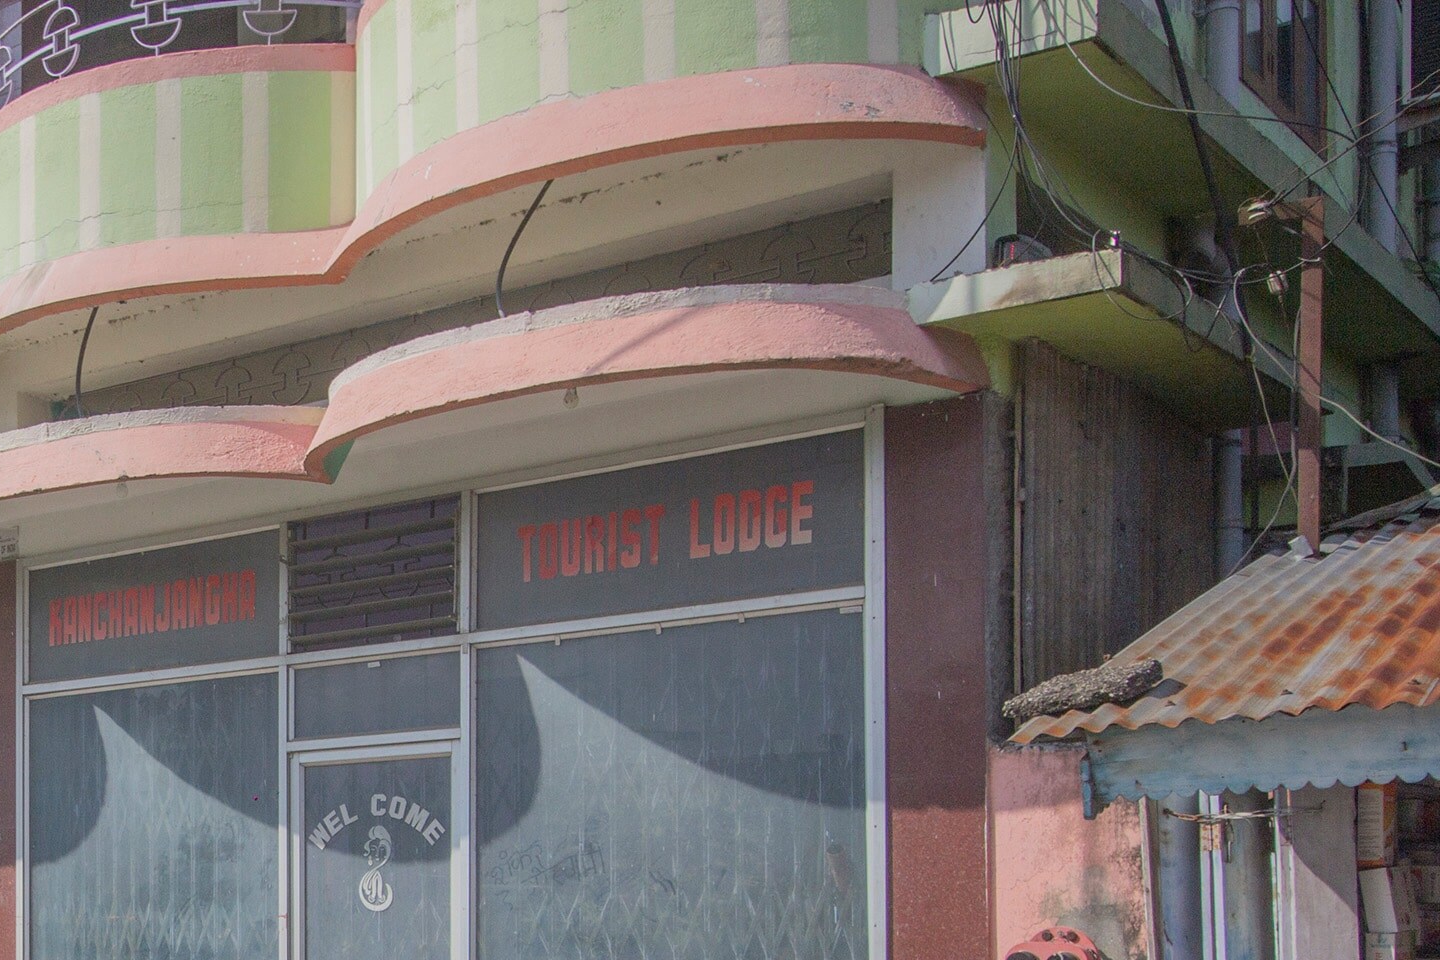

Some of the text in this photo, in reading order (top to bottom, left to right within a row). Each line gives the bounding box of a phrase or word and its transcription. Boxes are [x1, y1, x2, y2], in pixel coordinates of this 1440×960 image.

[517, 479, 814, 583] TOURIST LODGE
[48, 568, 256, 647] KANCHANJANGHA
